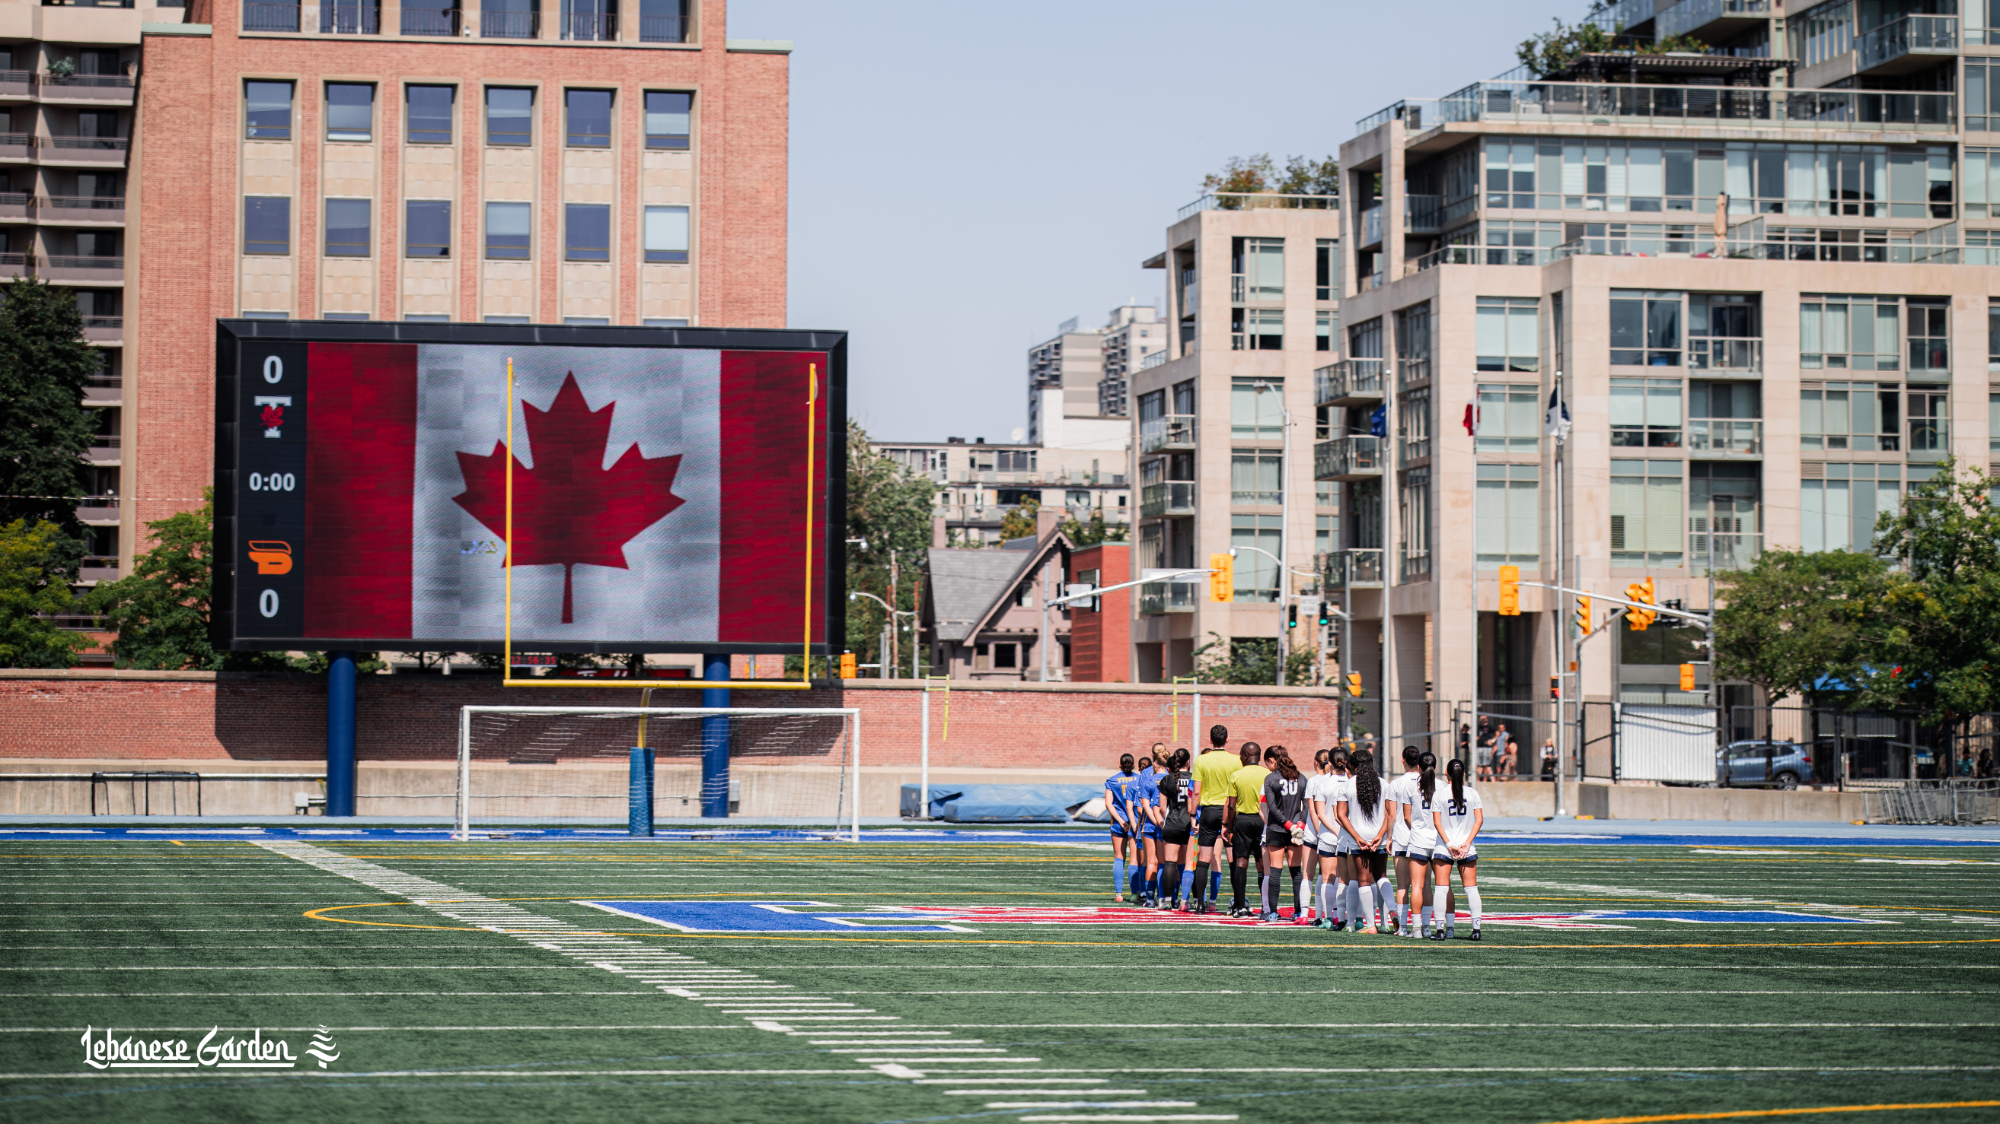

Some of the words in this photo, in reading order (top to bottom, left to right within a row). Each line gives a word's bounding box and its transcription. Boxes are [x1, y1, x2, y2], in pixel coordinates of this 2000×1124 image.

[263, 355, 284, 384] 0
[249, 472, 296, 492] 0:00
[259, 588, 280, 618] 0
[511, 656, 556, 664] 12:56:35
[1218, 704, 1310, 718] DAVENPORT
[1275, 719, 1310, 729] TRACK
[1279, 778, 1298, 796] 30
